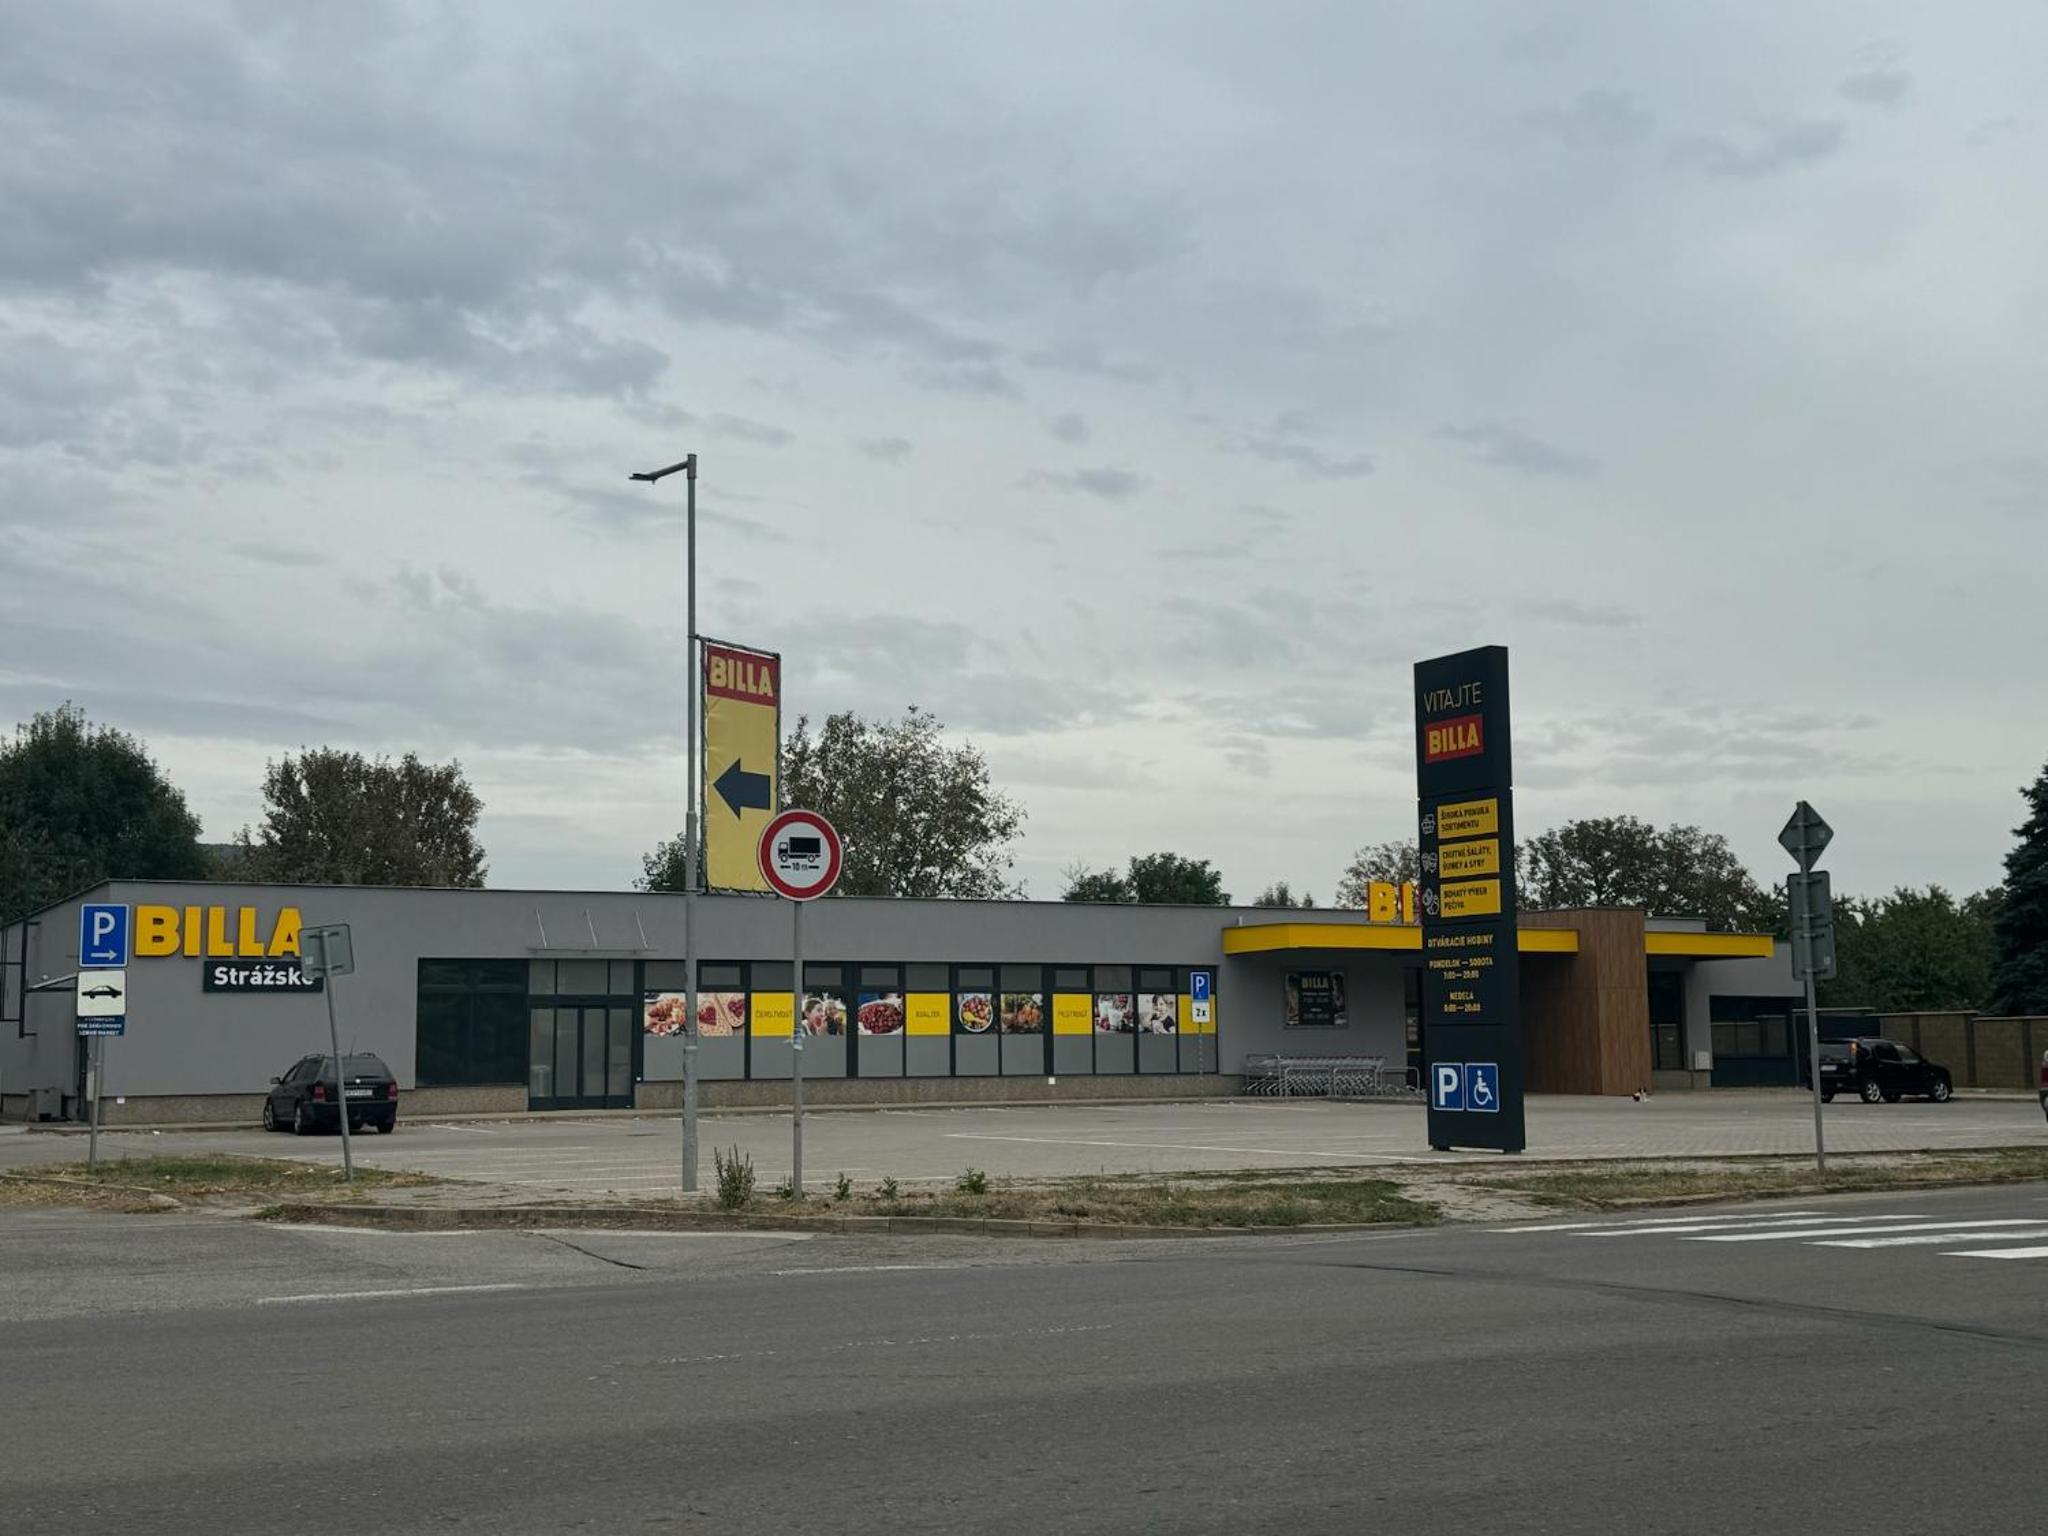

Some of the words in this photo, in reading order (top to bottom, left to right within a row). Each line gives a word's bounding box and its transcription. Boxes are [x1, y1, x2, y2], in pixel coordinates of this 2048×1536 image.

[710, 655, 773, 697] BILLA
[1424, 682, 1482, 714] VITAJTE
[1428, 723, 1480, 755] BILLA
[93, 911, 116, 946] P
[134, 905, 303, 957] BILLA
[1196, 975, 1205, 992] P
[1302, 976, 1329, 989] BILLA
[1438, 1067, 1459, 1105] P
